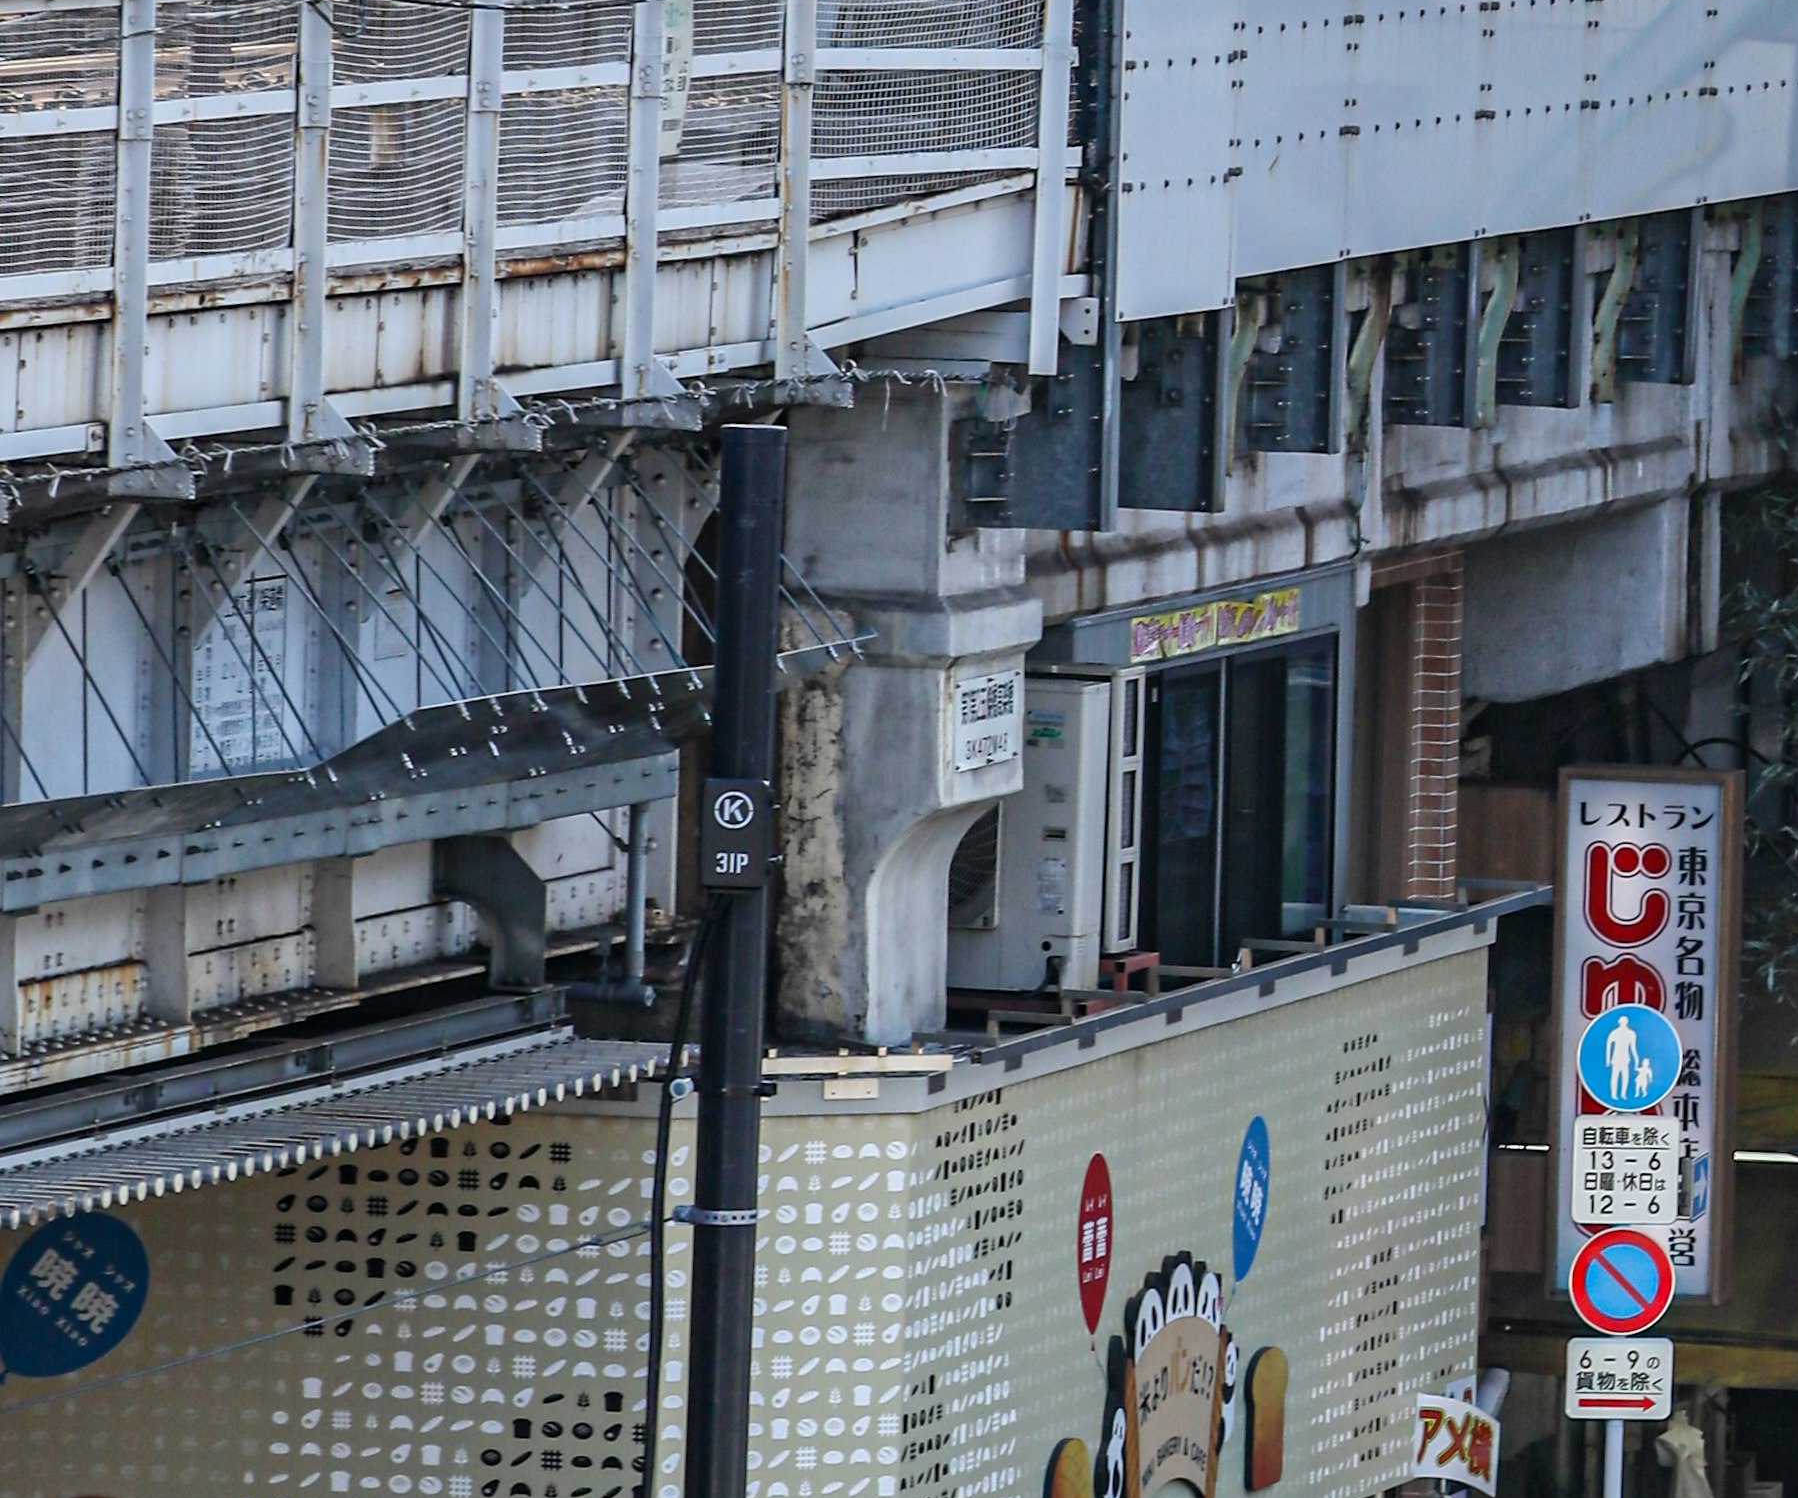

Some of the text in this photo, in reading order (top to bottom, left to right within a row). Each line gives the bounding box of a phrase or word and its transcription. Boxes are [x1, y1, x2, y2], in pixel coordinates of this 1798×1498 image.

[1579, 801, 1715, 830] レストラン
[1674, 846, 1708, 1021] 東京名物
[1582, 1126, 1670, 1146] 自転車を除く
[1584, 1171, 1666, 1192] 日曜・休日は
[16, 1286, 88, 1347] Xiao Xiao
[1575, 1371, 1663, 1391] 貨物を除く
[1417, 1407, 1492, 1484] アメ横
